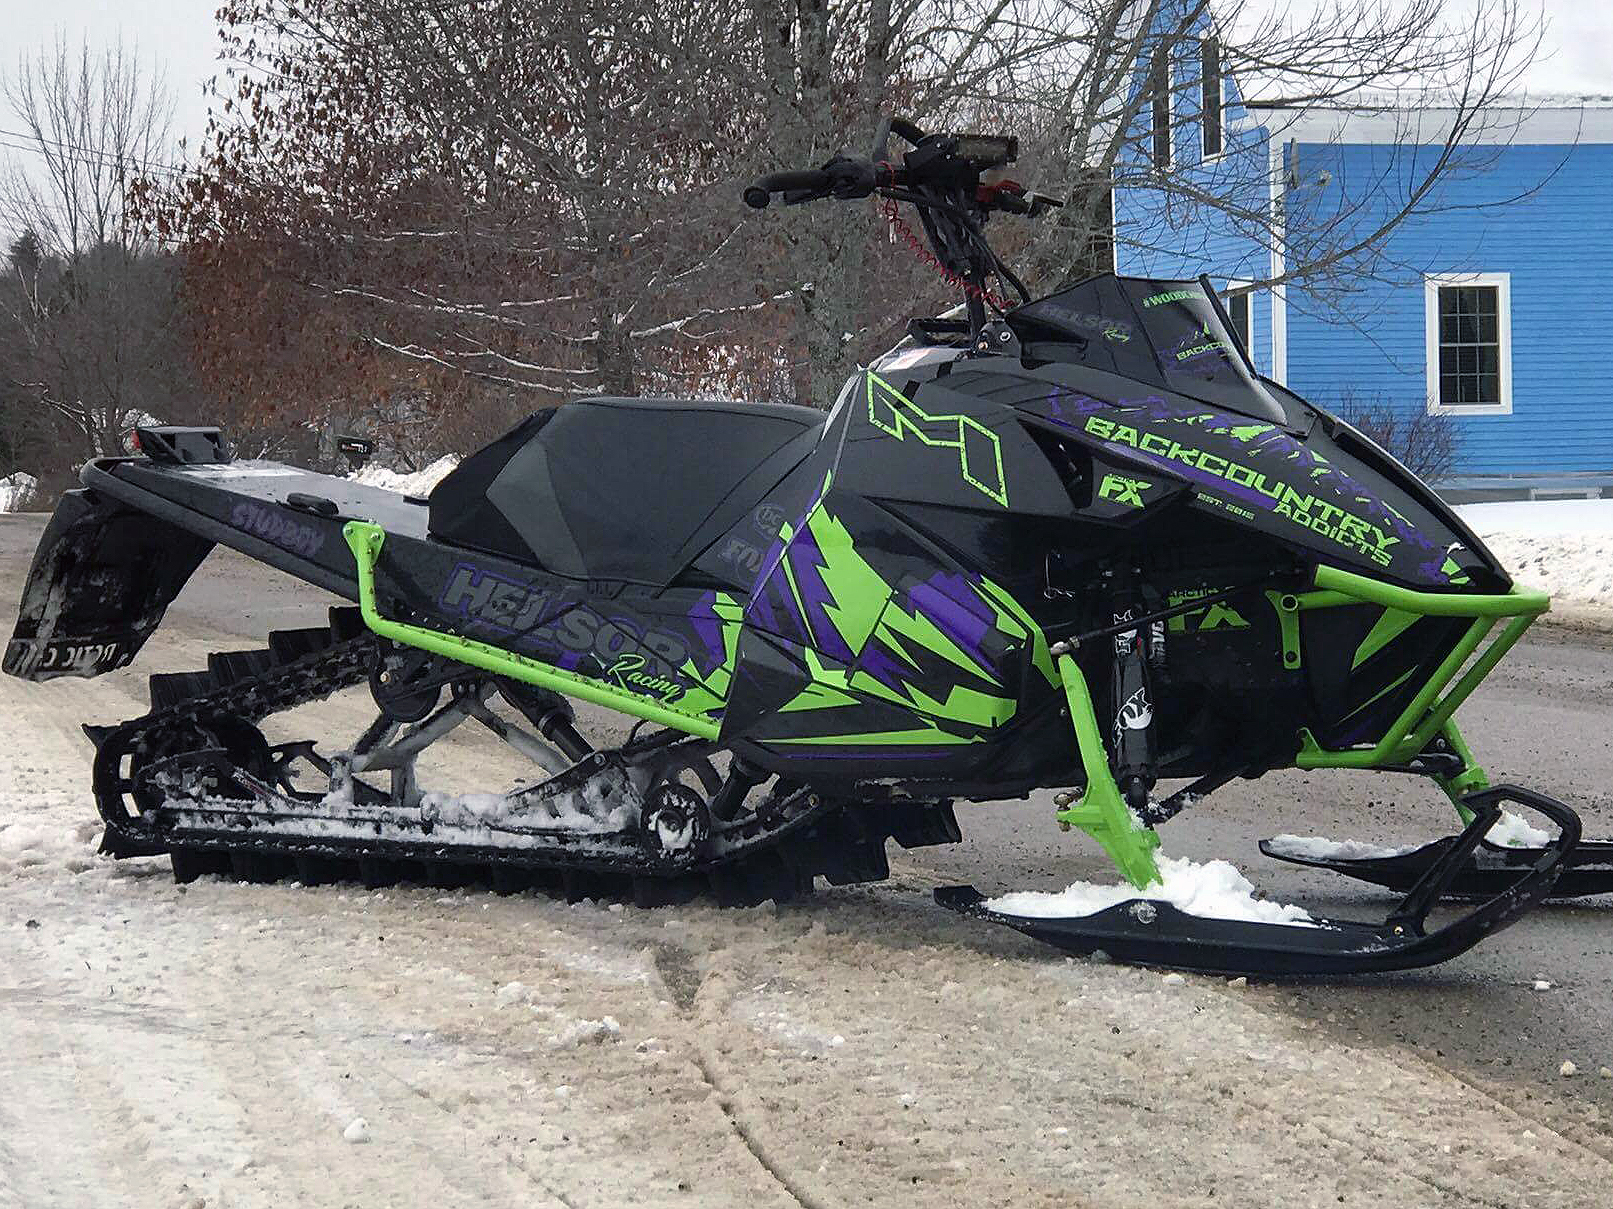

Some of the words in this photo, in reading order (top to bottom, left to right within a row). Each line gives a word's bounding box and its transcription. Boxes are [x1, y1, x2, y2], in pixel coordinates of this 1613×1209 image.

[1084, 416, 1401, 549] BACKCOUNTRY
[1098, 475, 1152, 508] FX
[1273, 501, 1394, 567] ADDICTS
[608, 654, 683, 701] Racing
